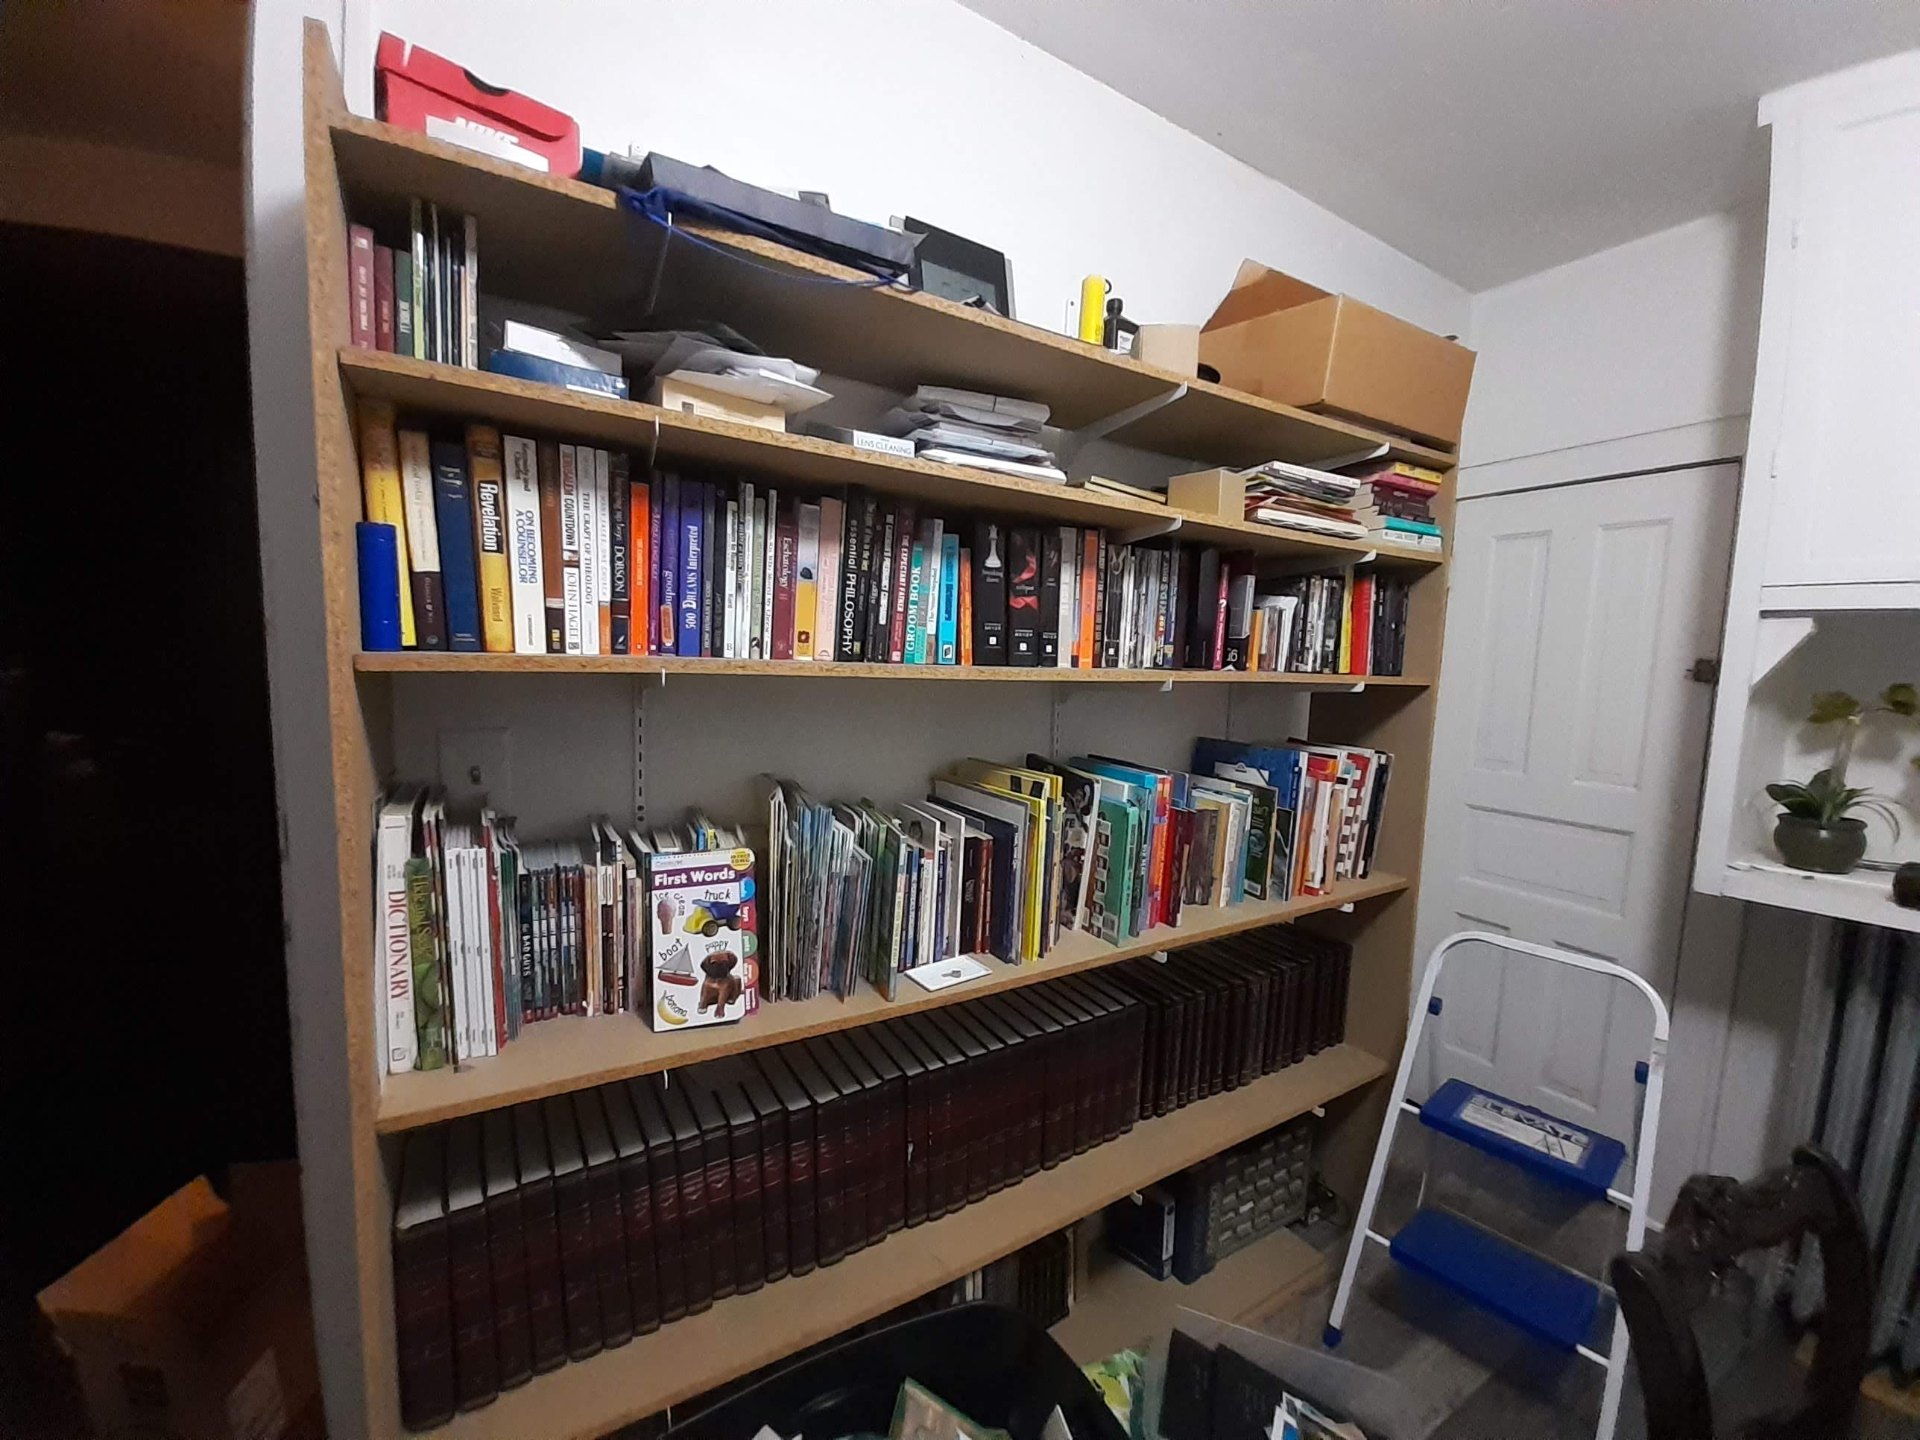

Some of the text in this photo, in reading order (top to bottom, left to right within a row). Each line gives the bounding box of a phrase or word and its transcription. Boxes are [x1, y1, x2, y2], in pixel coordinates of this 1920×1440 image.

[857, 437, 912, 454] LENS CLEANING
[562, 451, 576, 546] JERUSALEM COUNTDOWN
[479, 483, 501, 551] Revelation
[583, 514, 591, 539] CRAFT
[516, 519, 528, 583] COUNSELOR
[525, 510, 537, 583] ON BECOMING
[584, 543, 592, 555] OF
[686, 525, 701, 570] Interpreted
[848, 520, 858, 569] essential
[614, 546, 625, 592] DOBSON
[779, 537, 792, 589] Eschatology
[899, 548, 908, 586] EXPECTANT
[584, 557, 592, 605] THEOLOGY
[1159, 583, 1167, 613] KIDS
[566, 572, 579, 638] JOHN HAGEE
[842, 573, 857, 654] PHILOSOPHY
[897, 587, 906, 612] FATHER
[906, 567, 921, 651] GROOM BOOK
[685, 613, 696, 629] 500
[654, 867, 736, 886] First Words
[704, 888, 732, 900] truck
[742, 906, 750, 922] toys
[388, 890, 410, 1001] DICTIONARY
[522, 935, 531, 952] BAD
[659, 937, 684, 961] boat
[705, 940, 729, 953] puppy
[522, 954, 532, 976] GUYS
[663, 990, 688, 1017] banana
